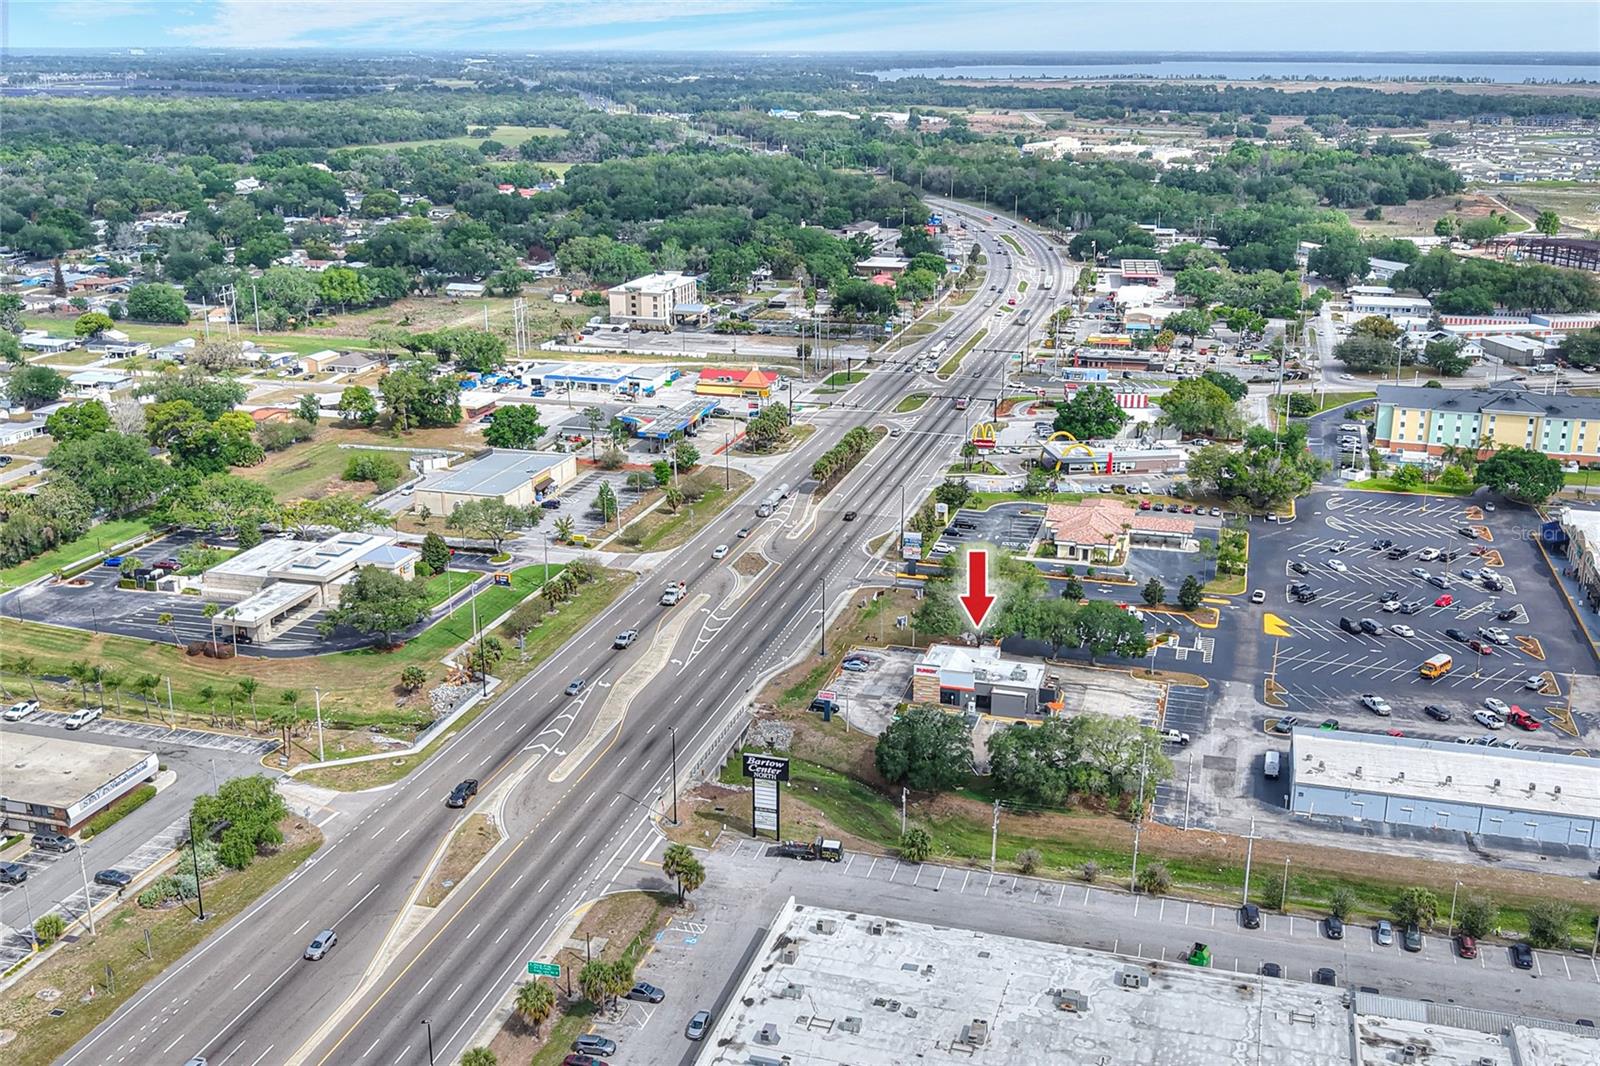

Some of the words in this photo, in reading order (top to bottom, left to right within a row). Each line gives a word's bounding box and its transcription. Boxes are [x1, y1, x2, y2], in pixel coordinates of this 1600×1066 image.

[747, 756, 784, 768] Bartow
[748, 764, 782, 775] Center
[753, 771, 777, 780] NORTH
